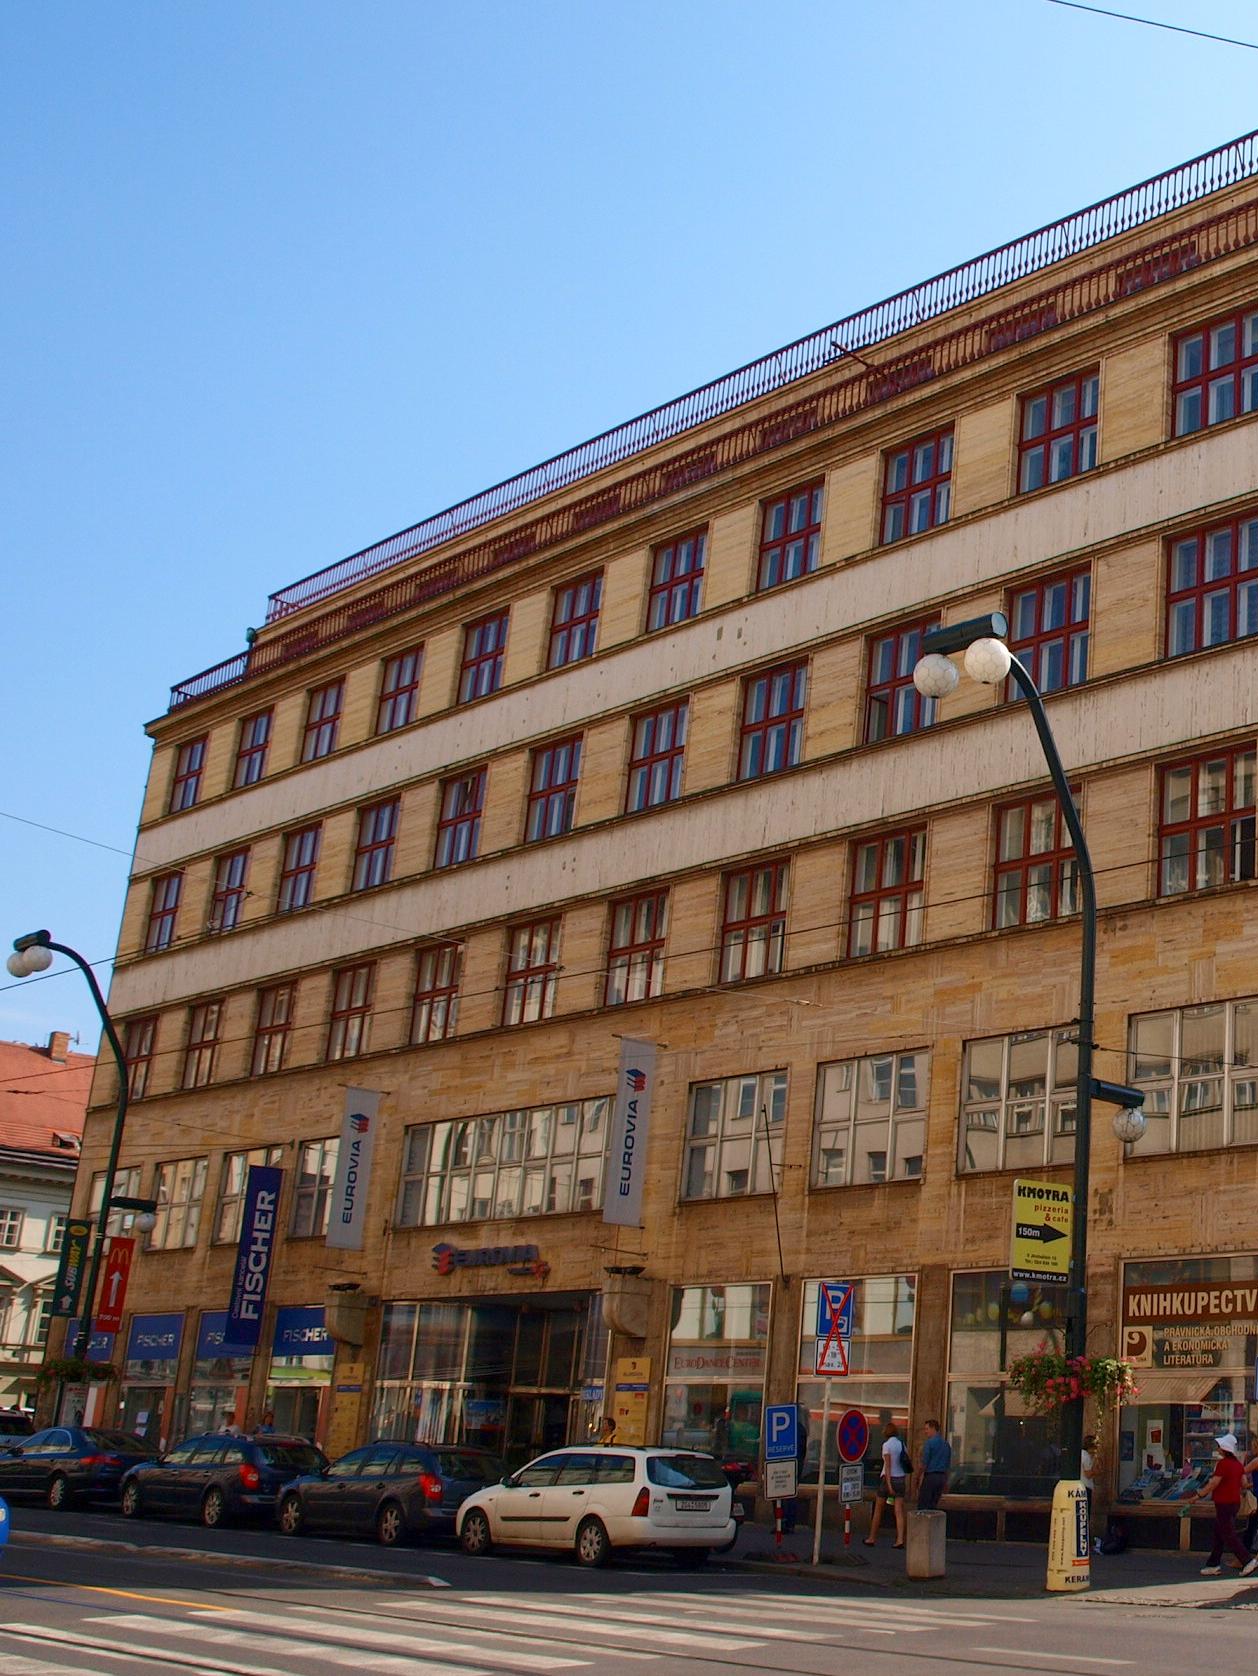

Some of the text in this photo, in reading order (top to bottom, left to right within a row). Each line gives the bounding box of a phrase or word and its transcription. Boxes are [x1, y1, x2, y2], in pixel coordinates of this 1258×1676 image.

[619, 1099, 639, 1196] EUROVIA
[342, 1140, 362, 1224] EUROVIA
[1017, 1185, 1070, 1202] KMOTRA
[1034, 1204, 1069, 1215] pizzeria
[1044, 1213, 1051, 1222] &
[1018, 1227, 1040, 1237] 150m
[239, 1190, 276, 1320] FISCHER
[65, 1240, 82, 1291] SUBWAY
[1013, 1271, 1067, 1281] www.kmotra.cz
[826, 1290, 845, 1319] P
[136, 1334, 175, 1347] FISCHER
[283, 1327, 328, 1342] FISCHER
[1164, 1341, 1170, 1351] A
[1164, 1355, 1214, 1365] LITERATURA
[772, 1412, 790, 1442] P
[1079, 1501, 1088, 1556] KOUPELNY
